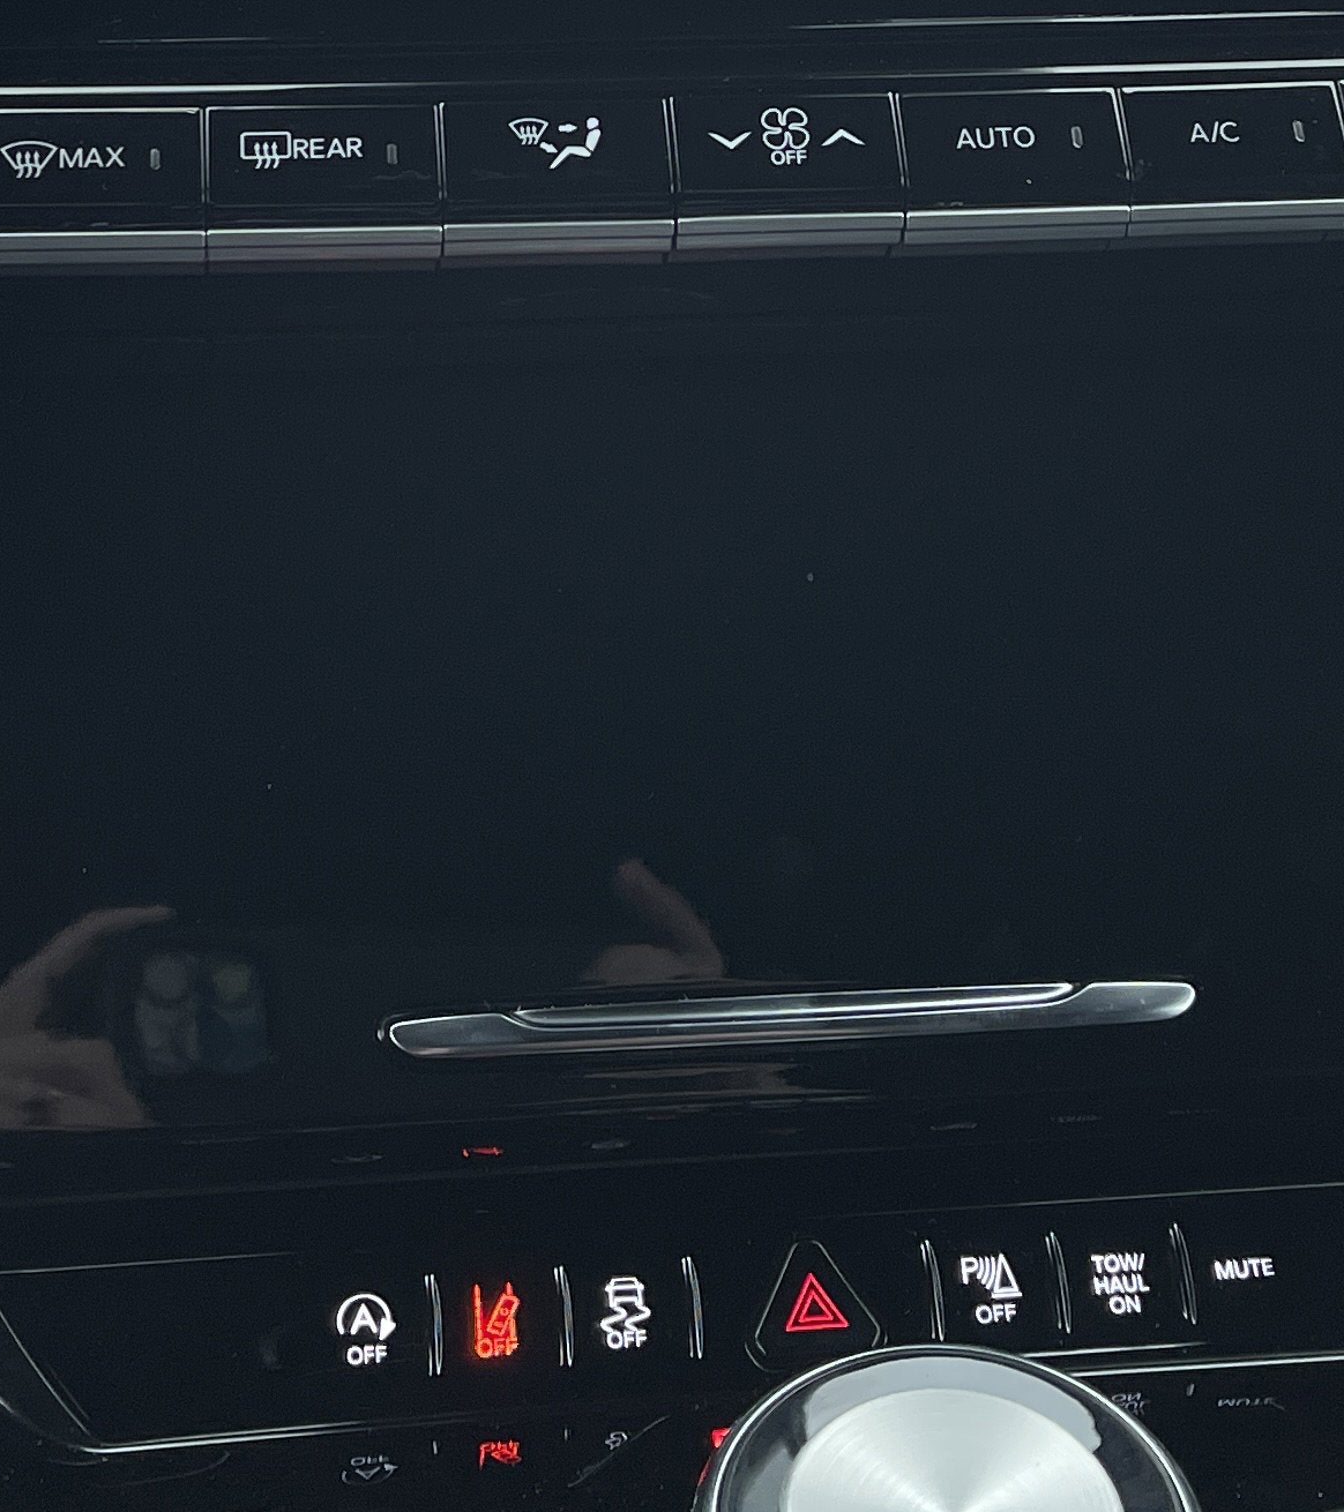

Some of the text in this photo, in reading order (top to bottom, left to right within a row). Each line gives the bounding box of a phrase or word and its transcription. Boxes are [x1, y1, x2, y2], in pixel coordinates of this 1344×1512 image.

[956, 126, 1036, 150] AUTO
[1190, 121, 1240, 144] A/C
[58, 146, 125, 169] MAX
[293, 137, 363, 160] REAR
[770, 149, 807, 165] OFF
[1213, 1257, 1276, 1281] MUTE
[1092, 1274, 1150, 1295] HAUL
[975, 1304, 1017, 1324] OFF
[1108, 1295, 1142, 1315] ON
[607, 1330, 648, 1350] OFF
[347, 1345, 388, 1366] OFF
